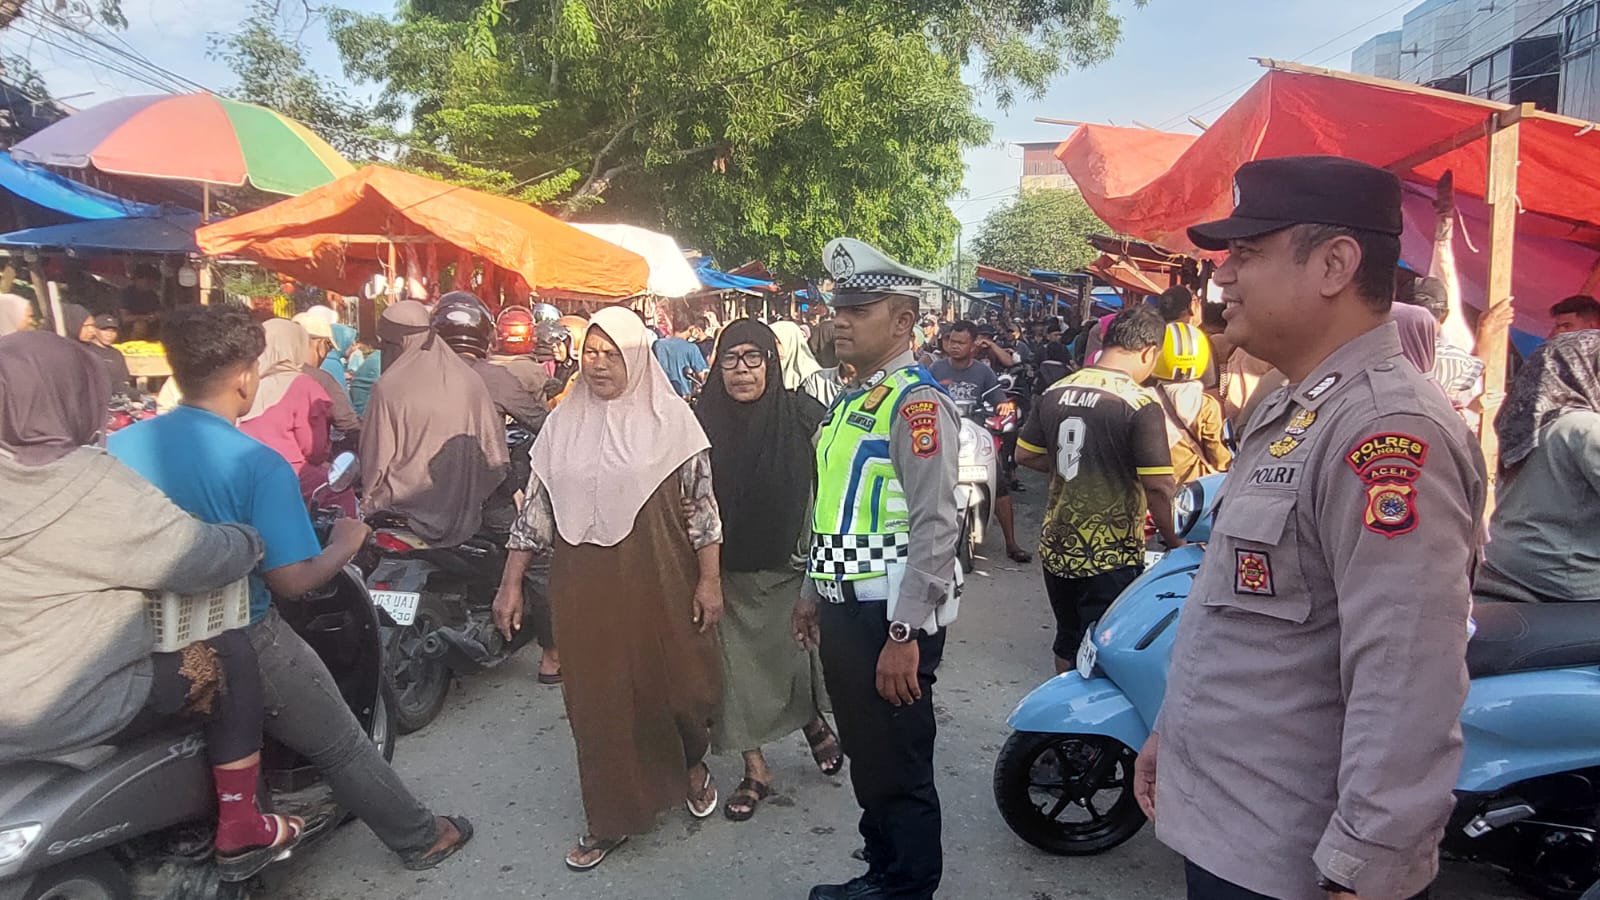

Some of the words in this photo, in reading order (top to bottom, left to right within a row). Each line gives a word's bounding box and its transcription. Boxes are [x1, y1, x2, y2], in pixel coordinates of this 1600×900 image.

[1058, 390, 1101, 408] ALAM
[1056, 416, 1086, 482] 8
[1351, 436, 1422, 463] POLRES
[1363, 447, 1409, 462] LANGSA
[1248, 466, 1296, 484] POLRI
[1371, 467, 1408, 478] ACEH
